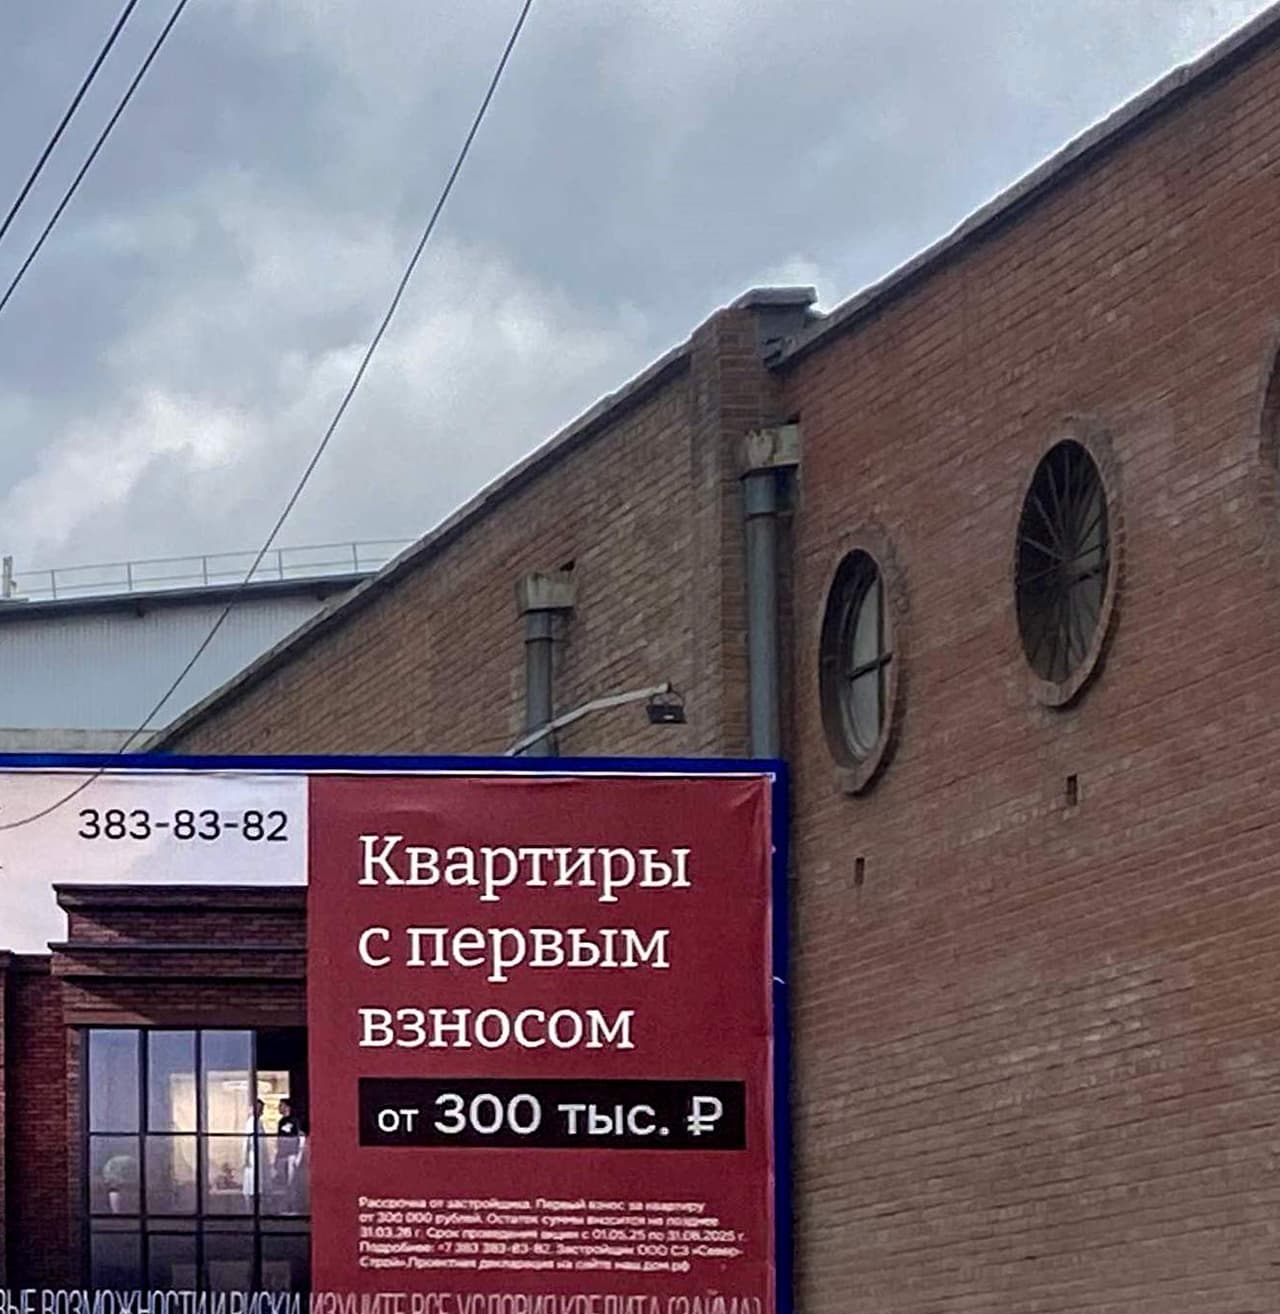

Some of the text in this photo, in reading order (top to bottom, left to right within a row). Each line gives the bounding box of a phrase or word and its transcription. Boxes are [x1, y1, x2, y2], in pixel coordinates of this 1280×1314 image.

[77, 808, 289, 842] 383-83-82
[358, 834, 692, 901] Квартиры
[358, 925, 671, 983] с первым
[358, 1007, 635, 1050] взносом
[376, 1092, 723, 1137] от 300 тыс. ₽
[377, 1212, 403, 1224] 300
[405, 1212, 433, 1224] 000
